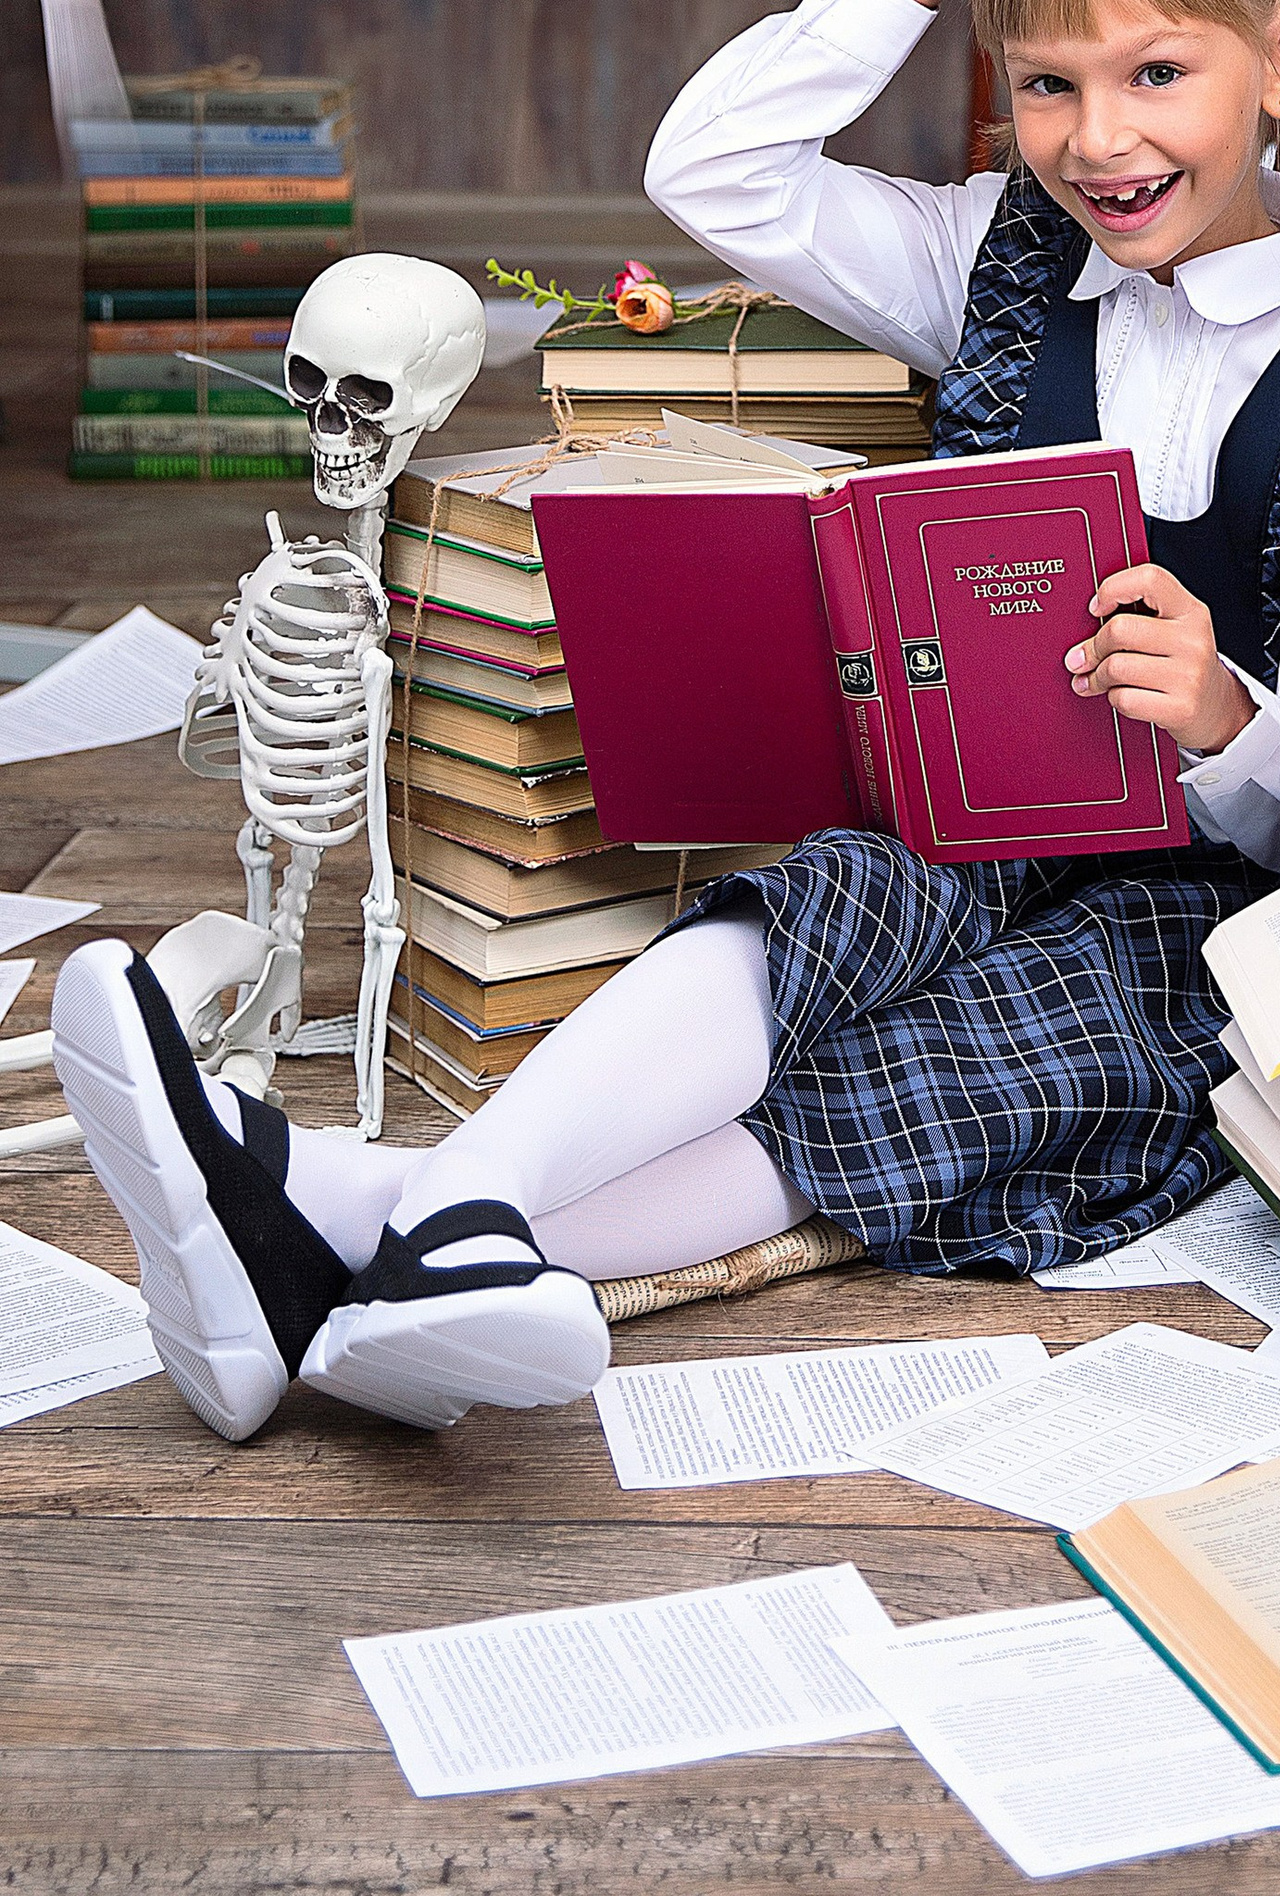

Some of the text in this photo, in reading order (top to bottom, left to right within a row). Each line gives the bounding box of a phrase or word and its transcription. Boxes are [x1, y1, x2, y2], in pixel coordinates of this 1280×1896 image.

[954, 559, 1065, 582] РОЖДЕНИЕ
[973, 579, 1053, 599] НОВОГО
[989, 598, 1044, 617] МИРА
[855, 704, 869, 734] МИРА
[860, 736, 876, 780] НОВОГО
[904, 1624, 1016, 1649] ПЕРЕРАБОТАННОЕ
